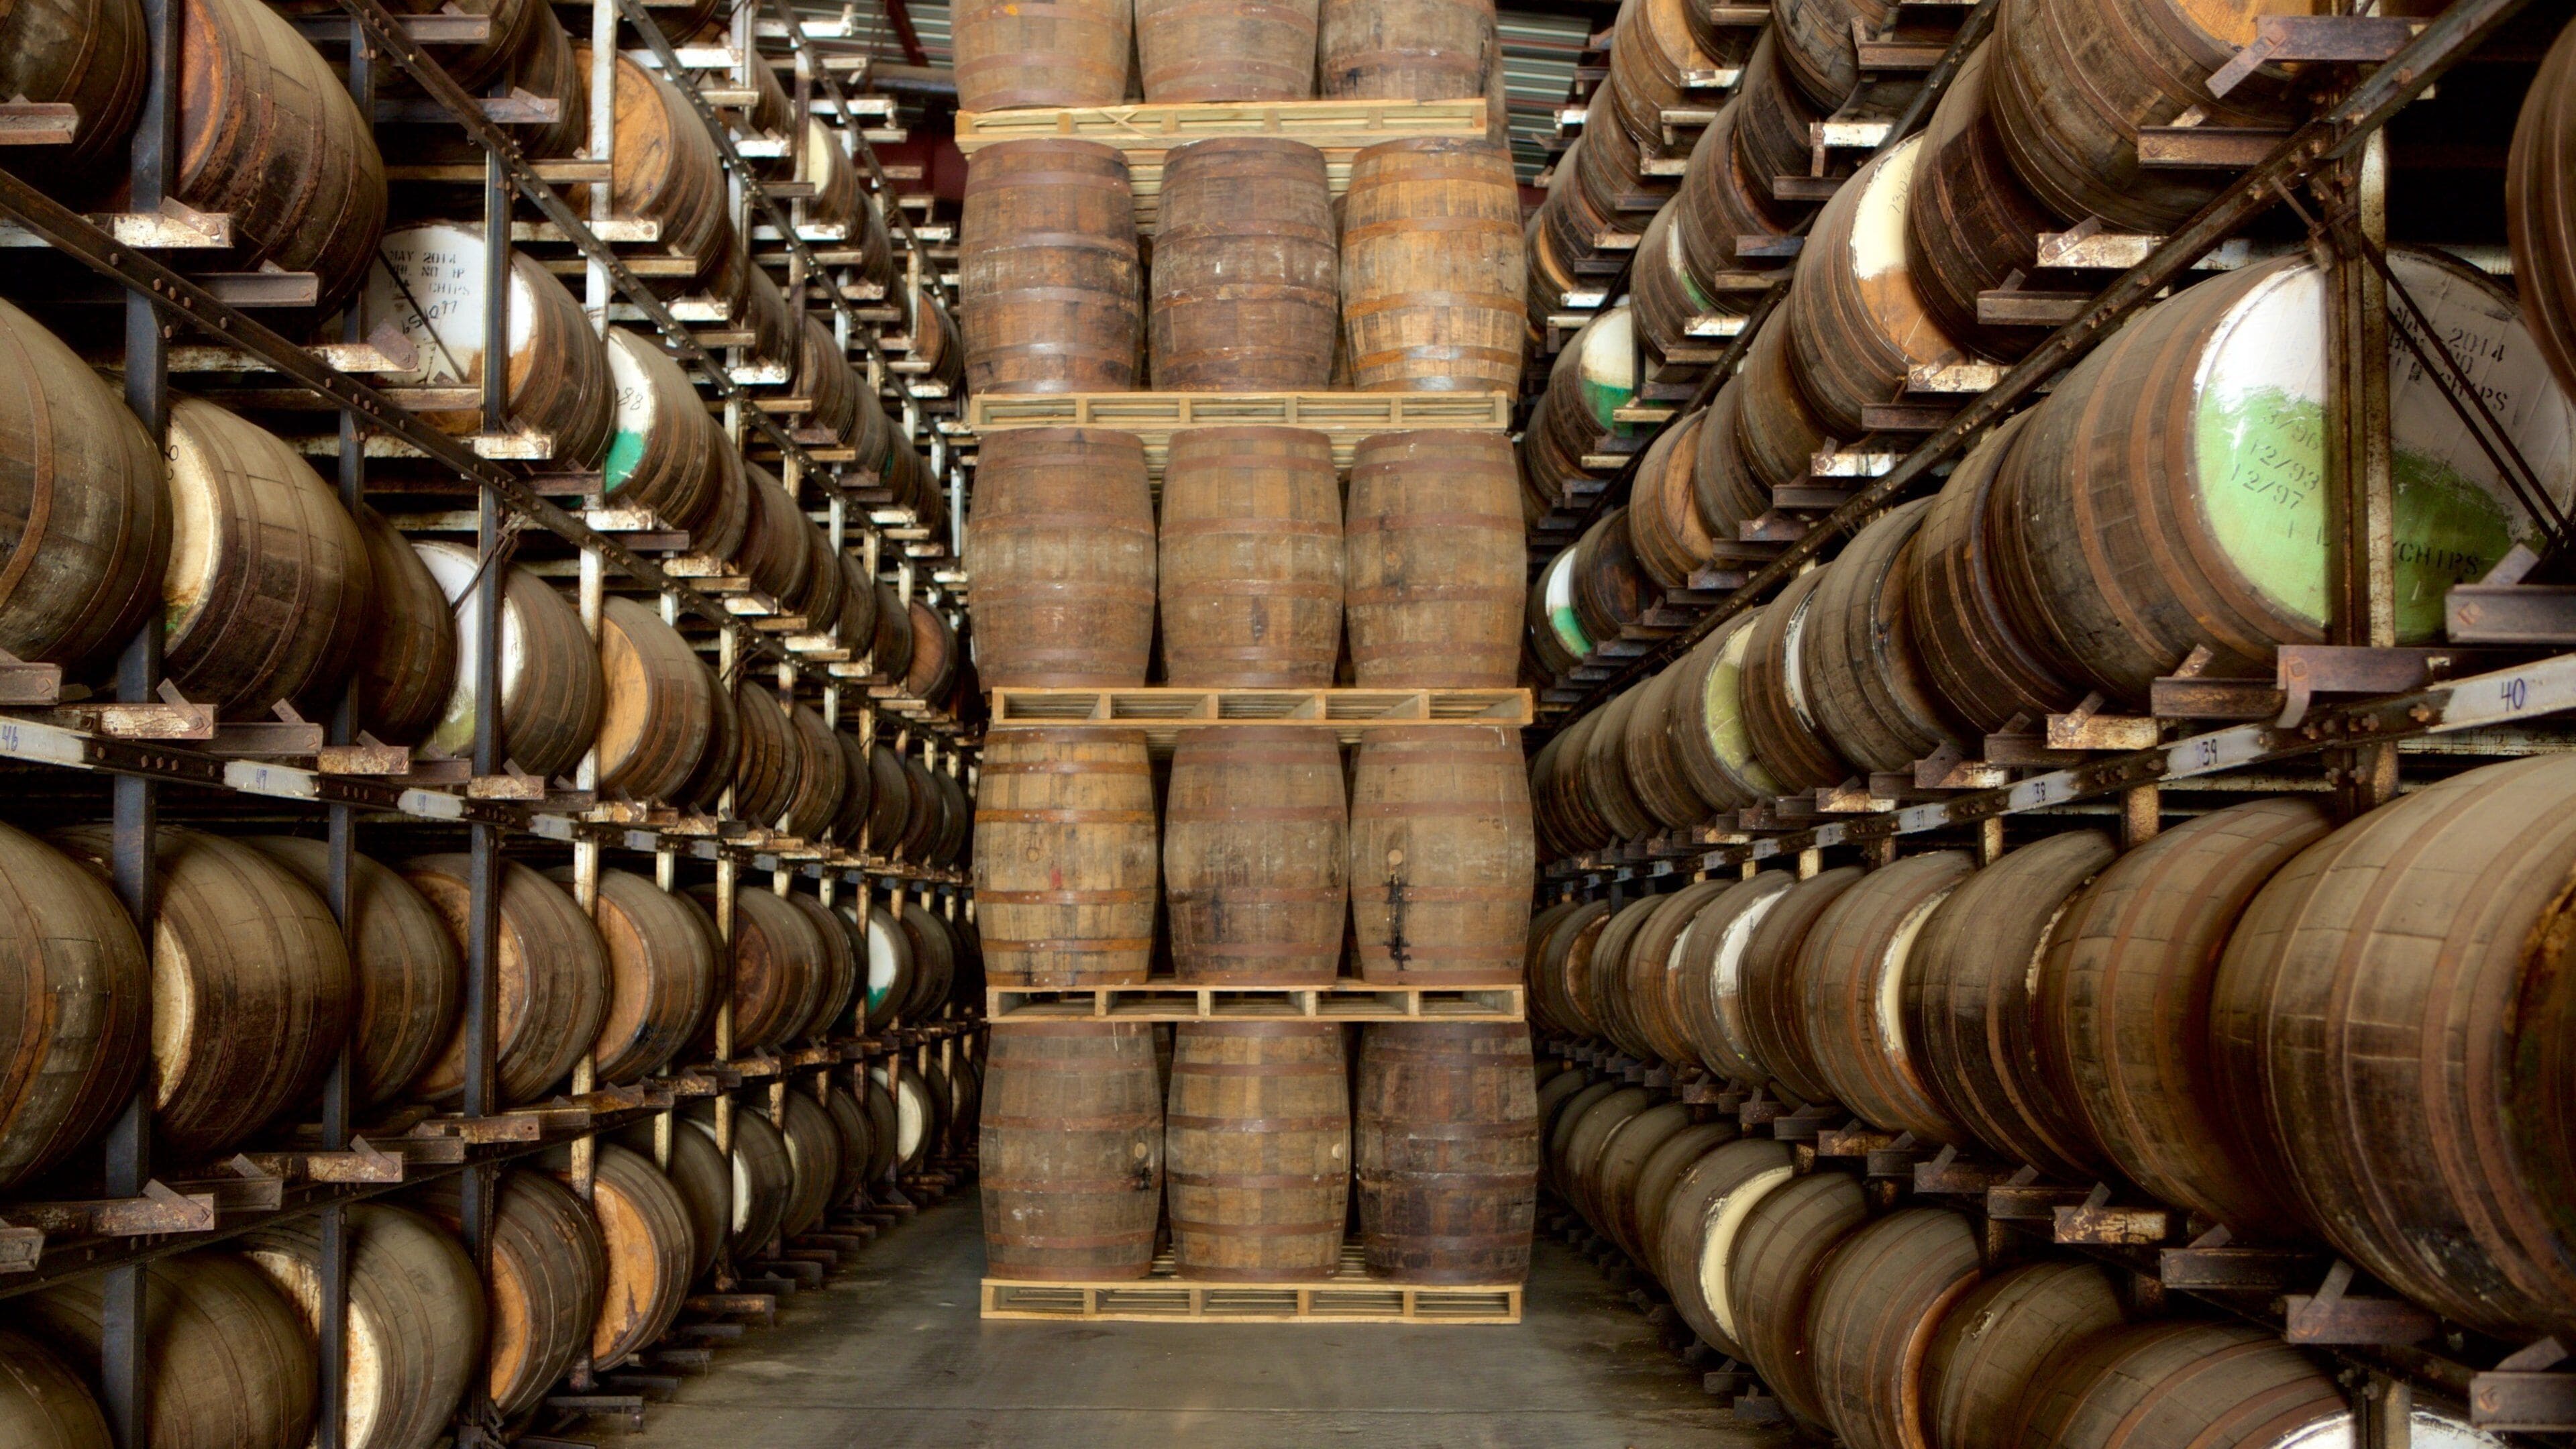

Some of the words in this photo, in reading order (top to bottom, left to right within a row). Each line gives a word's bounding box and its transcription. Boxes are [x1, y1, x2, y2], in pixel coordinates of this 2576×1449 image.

[423, 252, 456, 264] 2014
[2447, 327, 2506, 363] 2014
[2250, 439, 2320, 491] 12/93
[2231, 463, 2305, 510] 12/97
[2500, 677, 2526, 712] 40
[1, 725, 19, 751] 46
